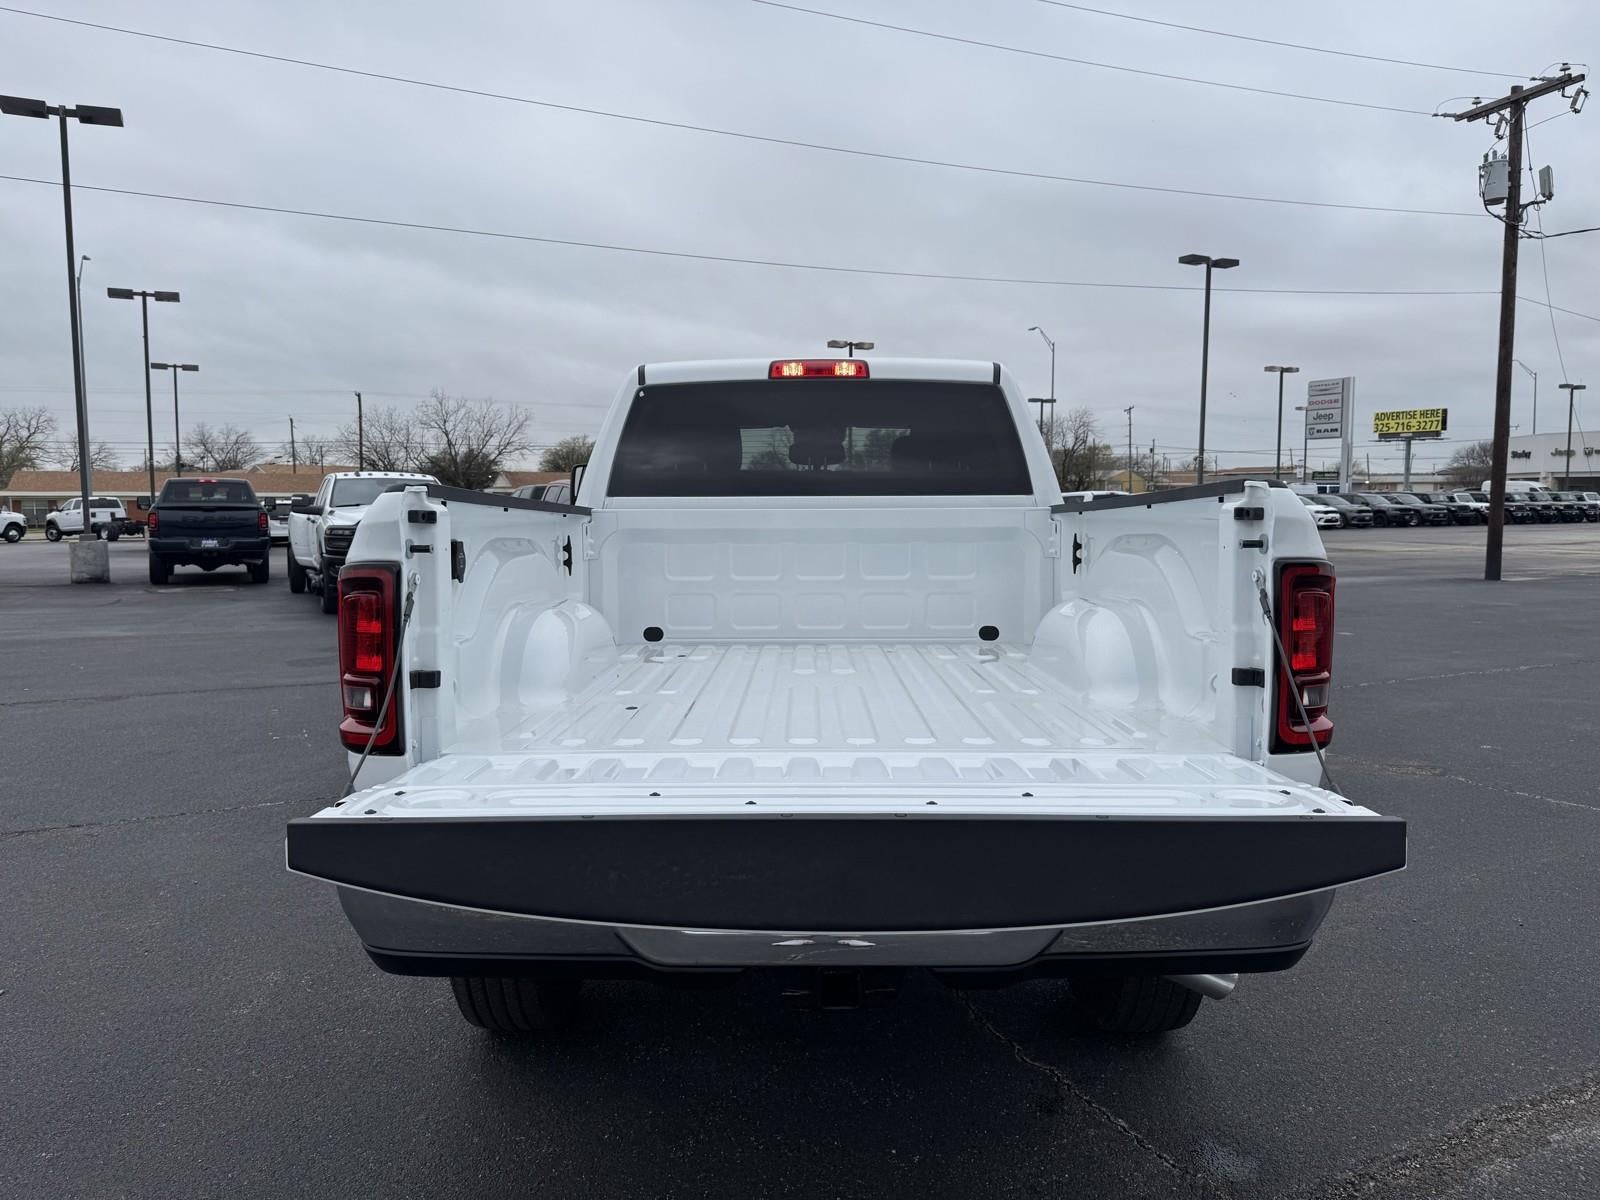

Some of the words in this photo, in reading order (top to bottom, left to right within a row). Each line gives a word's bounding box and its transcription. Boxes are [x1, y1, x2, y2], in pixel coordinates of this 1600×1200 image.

[1313, 412, 1334, 421] Jeep
[1374, 410, 1418, 422] ADVERTISE
[1419, 408, 1441, 419] HERE
[1373, 420, 1440, 433] 325-716-3277
